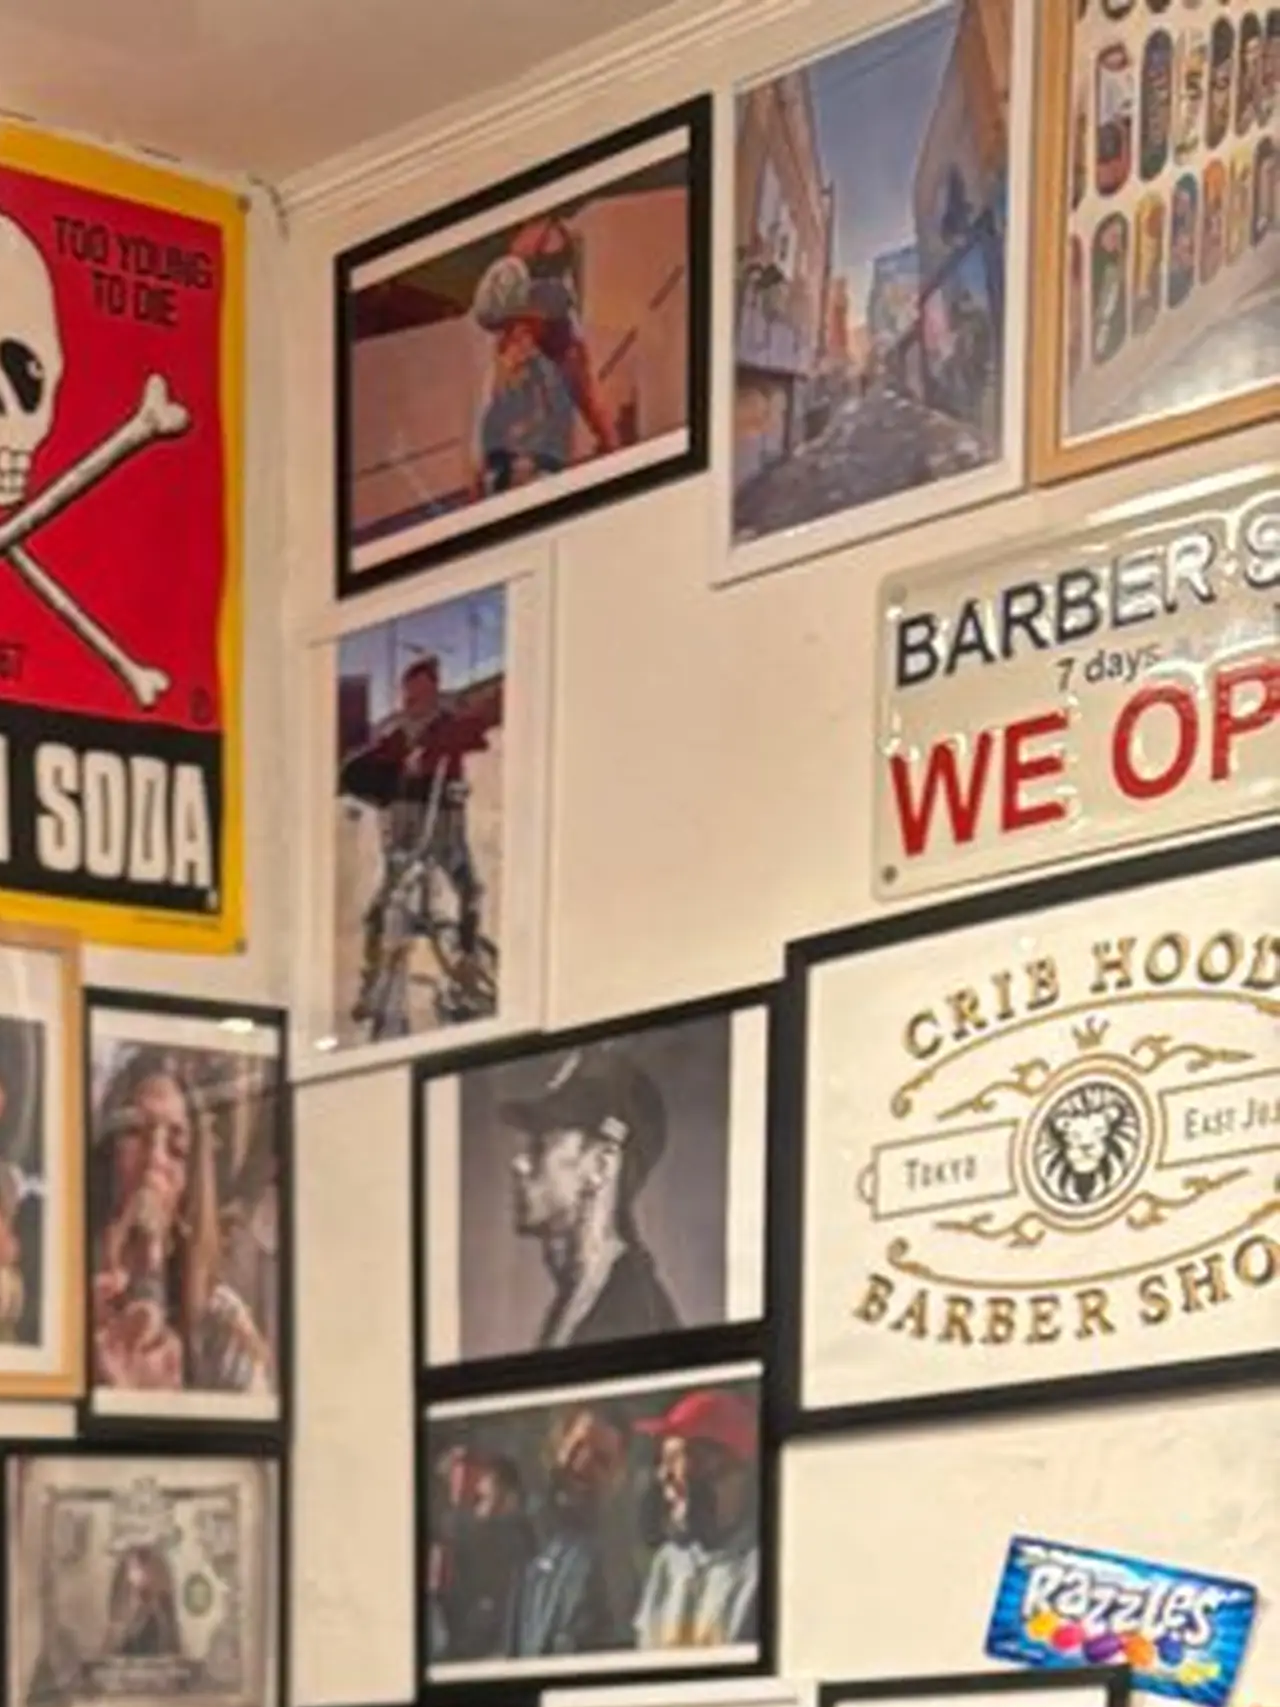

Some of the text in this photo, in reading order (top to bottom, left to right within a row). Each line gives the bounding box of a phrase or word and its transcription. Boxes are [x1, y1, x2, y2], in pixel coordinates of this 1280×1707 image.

[53, 215, 213, 291] TOO YOUNG
[92, 269, 178, 329] TO DIE
[1055, 643, 1162, 693] 7 days
[36, 743, 213, 888] SODA
[889, 706, 1071, 858] WE
[904, 957, 1060, 1061] CRIB
[853, 1273, 1117, 1346] BARBER
